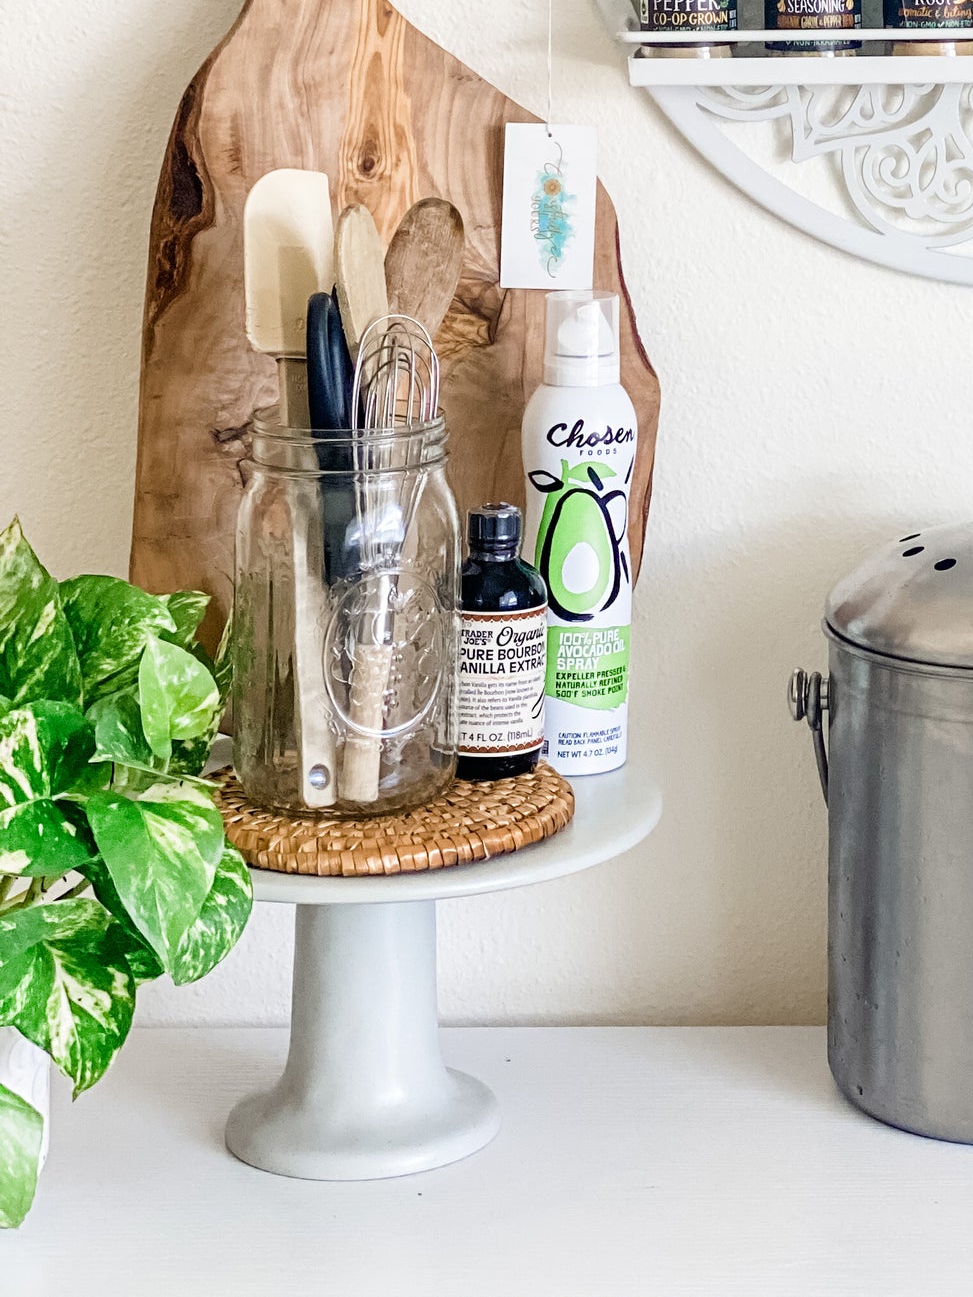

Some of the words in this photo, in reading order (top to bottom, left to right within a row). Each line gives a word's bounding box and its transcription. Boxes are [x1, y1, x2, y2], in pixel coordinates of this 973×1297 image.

[654, 12, 688, 25] CO-OP
[689, 11, 728, 25] GROWN
[547, 419, 635, 447] Chosen
[579, 448, 617, 456] FOODS
[461, 629, 493, 638] TRADER
[560, 632, 592, 645] 100%
[593, 629, 620, 644] PURE
[464, 638, 489, 646] JOE'S
[557, 642, 612, 658] AVOCADO
[613, 639, 625, 653] OIL
[460, 647, 494, 661] PURE
[460, 662, 506, 674] ANILLA
[557, 657, 600, 670] SPRAY
[556, 672, 595, 680] EXPELLER
[596, 666, 622, 678] PRESSED
[555, 679, 598, 689] NATURALLY
[599, 675, 624, 687] REFINED
[582, 688, 606, 697] SMOKE
